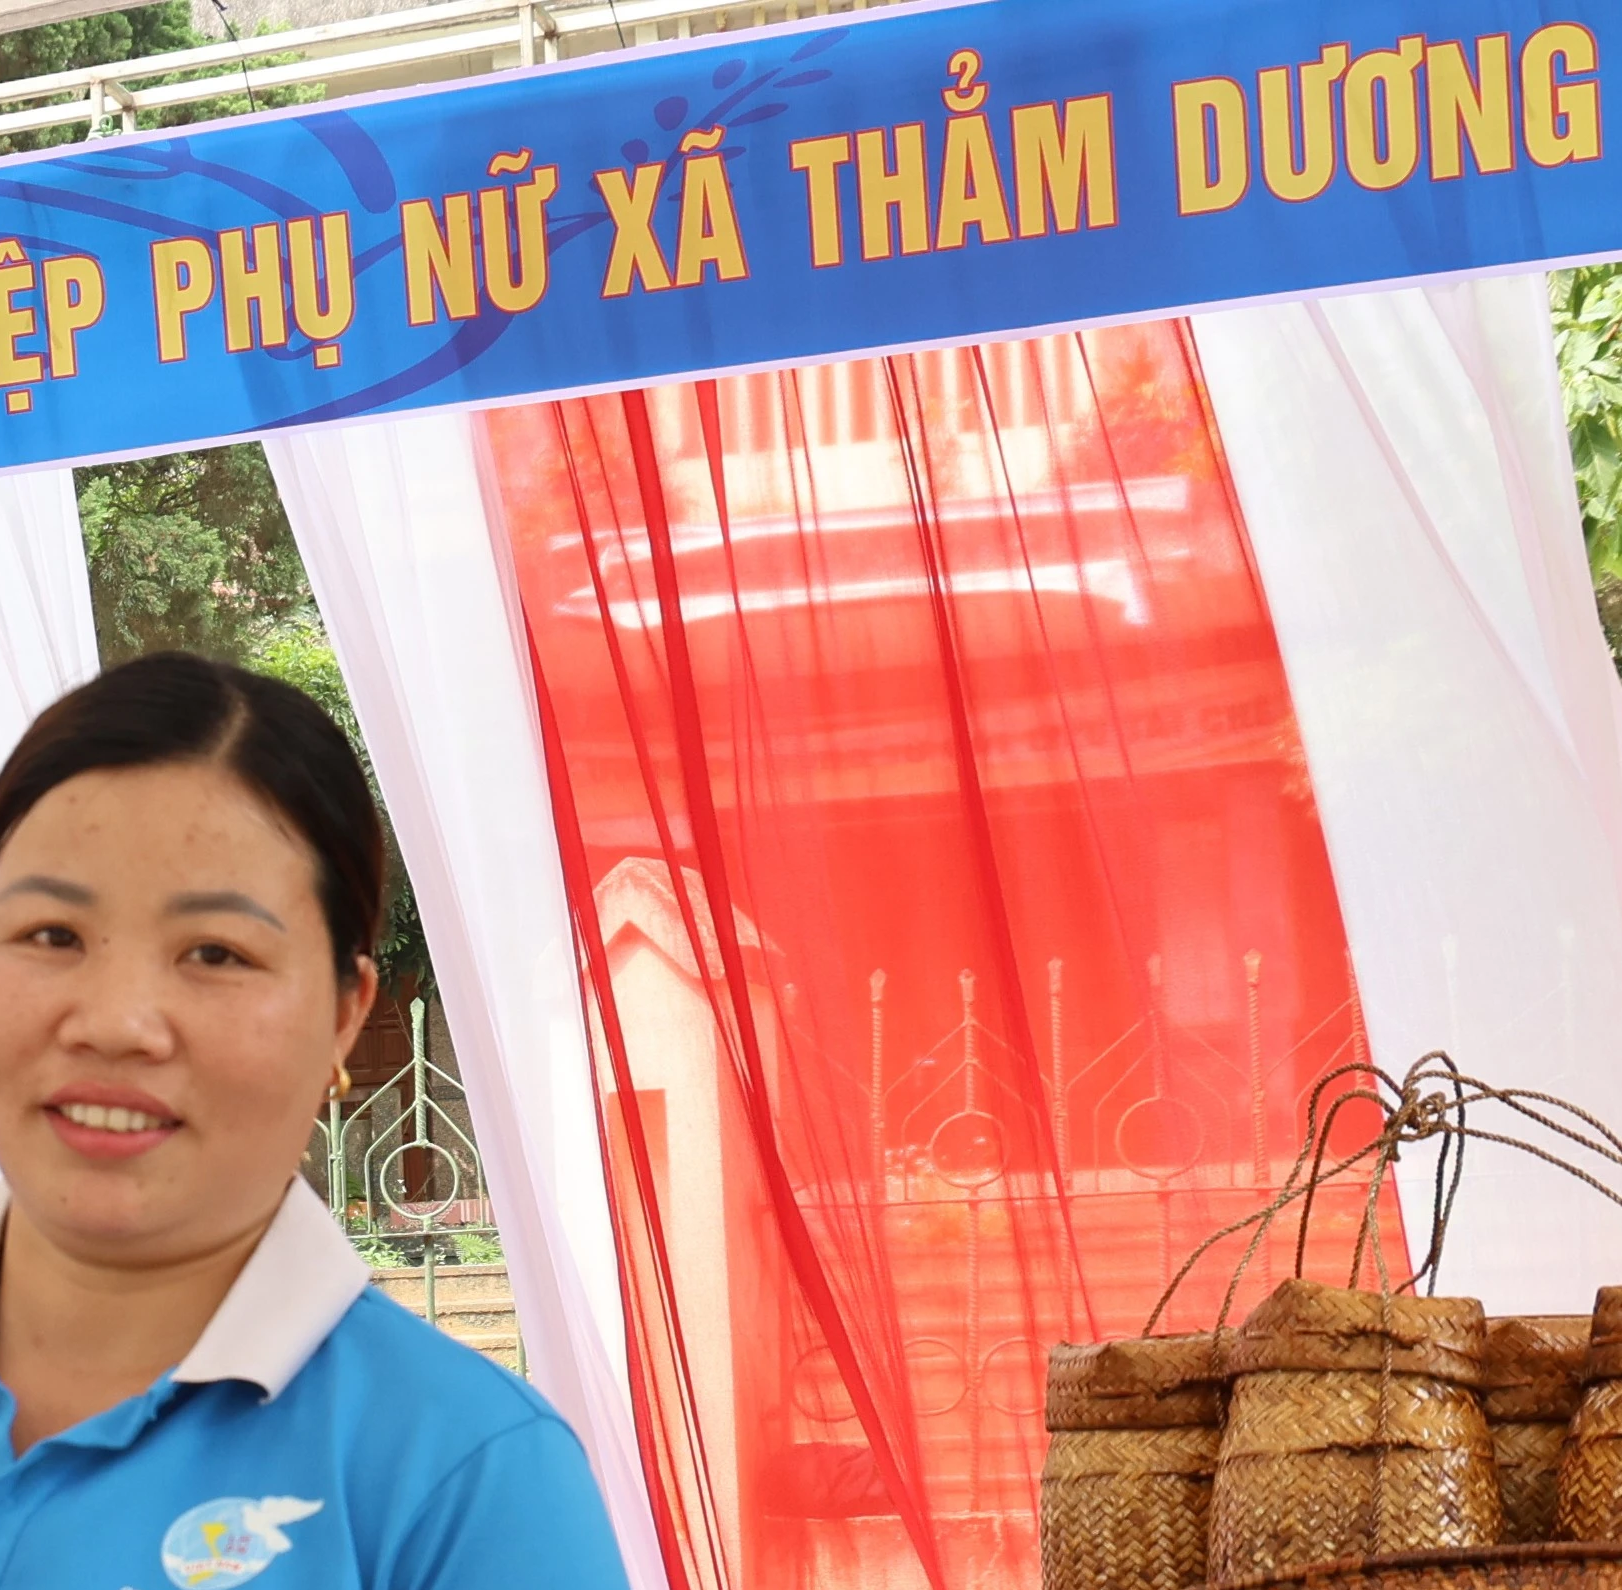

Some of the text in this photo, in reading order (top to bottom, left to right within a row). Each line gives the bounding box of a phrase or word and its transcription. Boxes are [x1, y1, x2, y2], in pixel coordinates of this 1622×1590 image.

[149, 210, 355, 371] PHỤ
[400, 146, 560, 327] NỮ
[593, 123, 750, 300] XÃ
[789, 48, 1118, 269] THẲM
[1171, 22, 1603, 217] DƯƠNG
